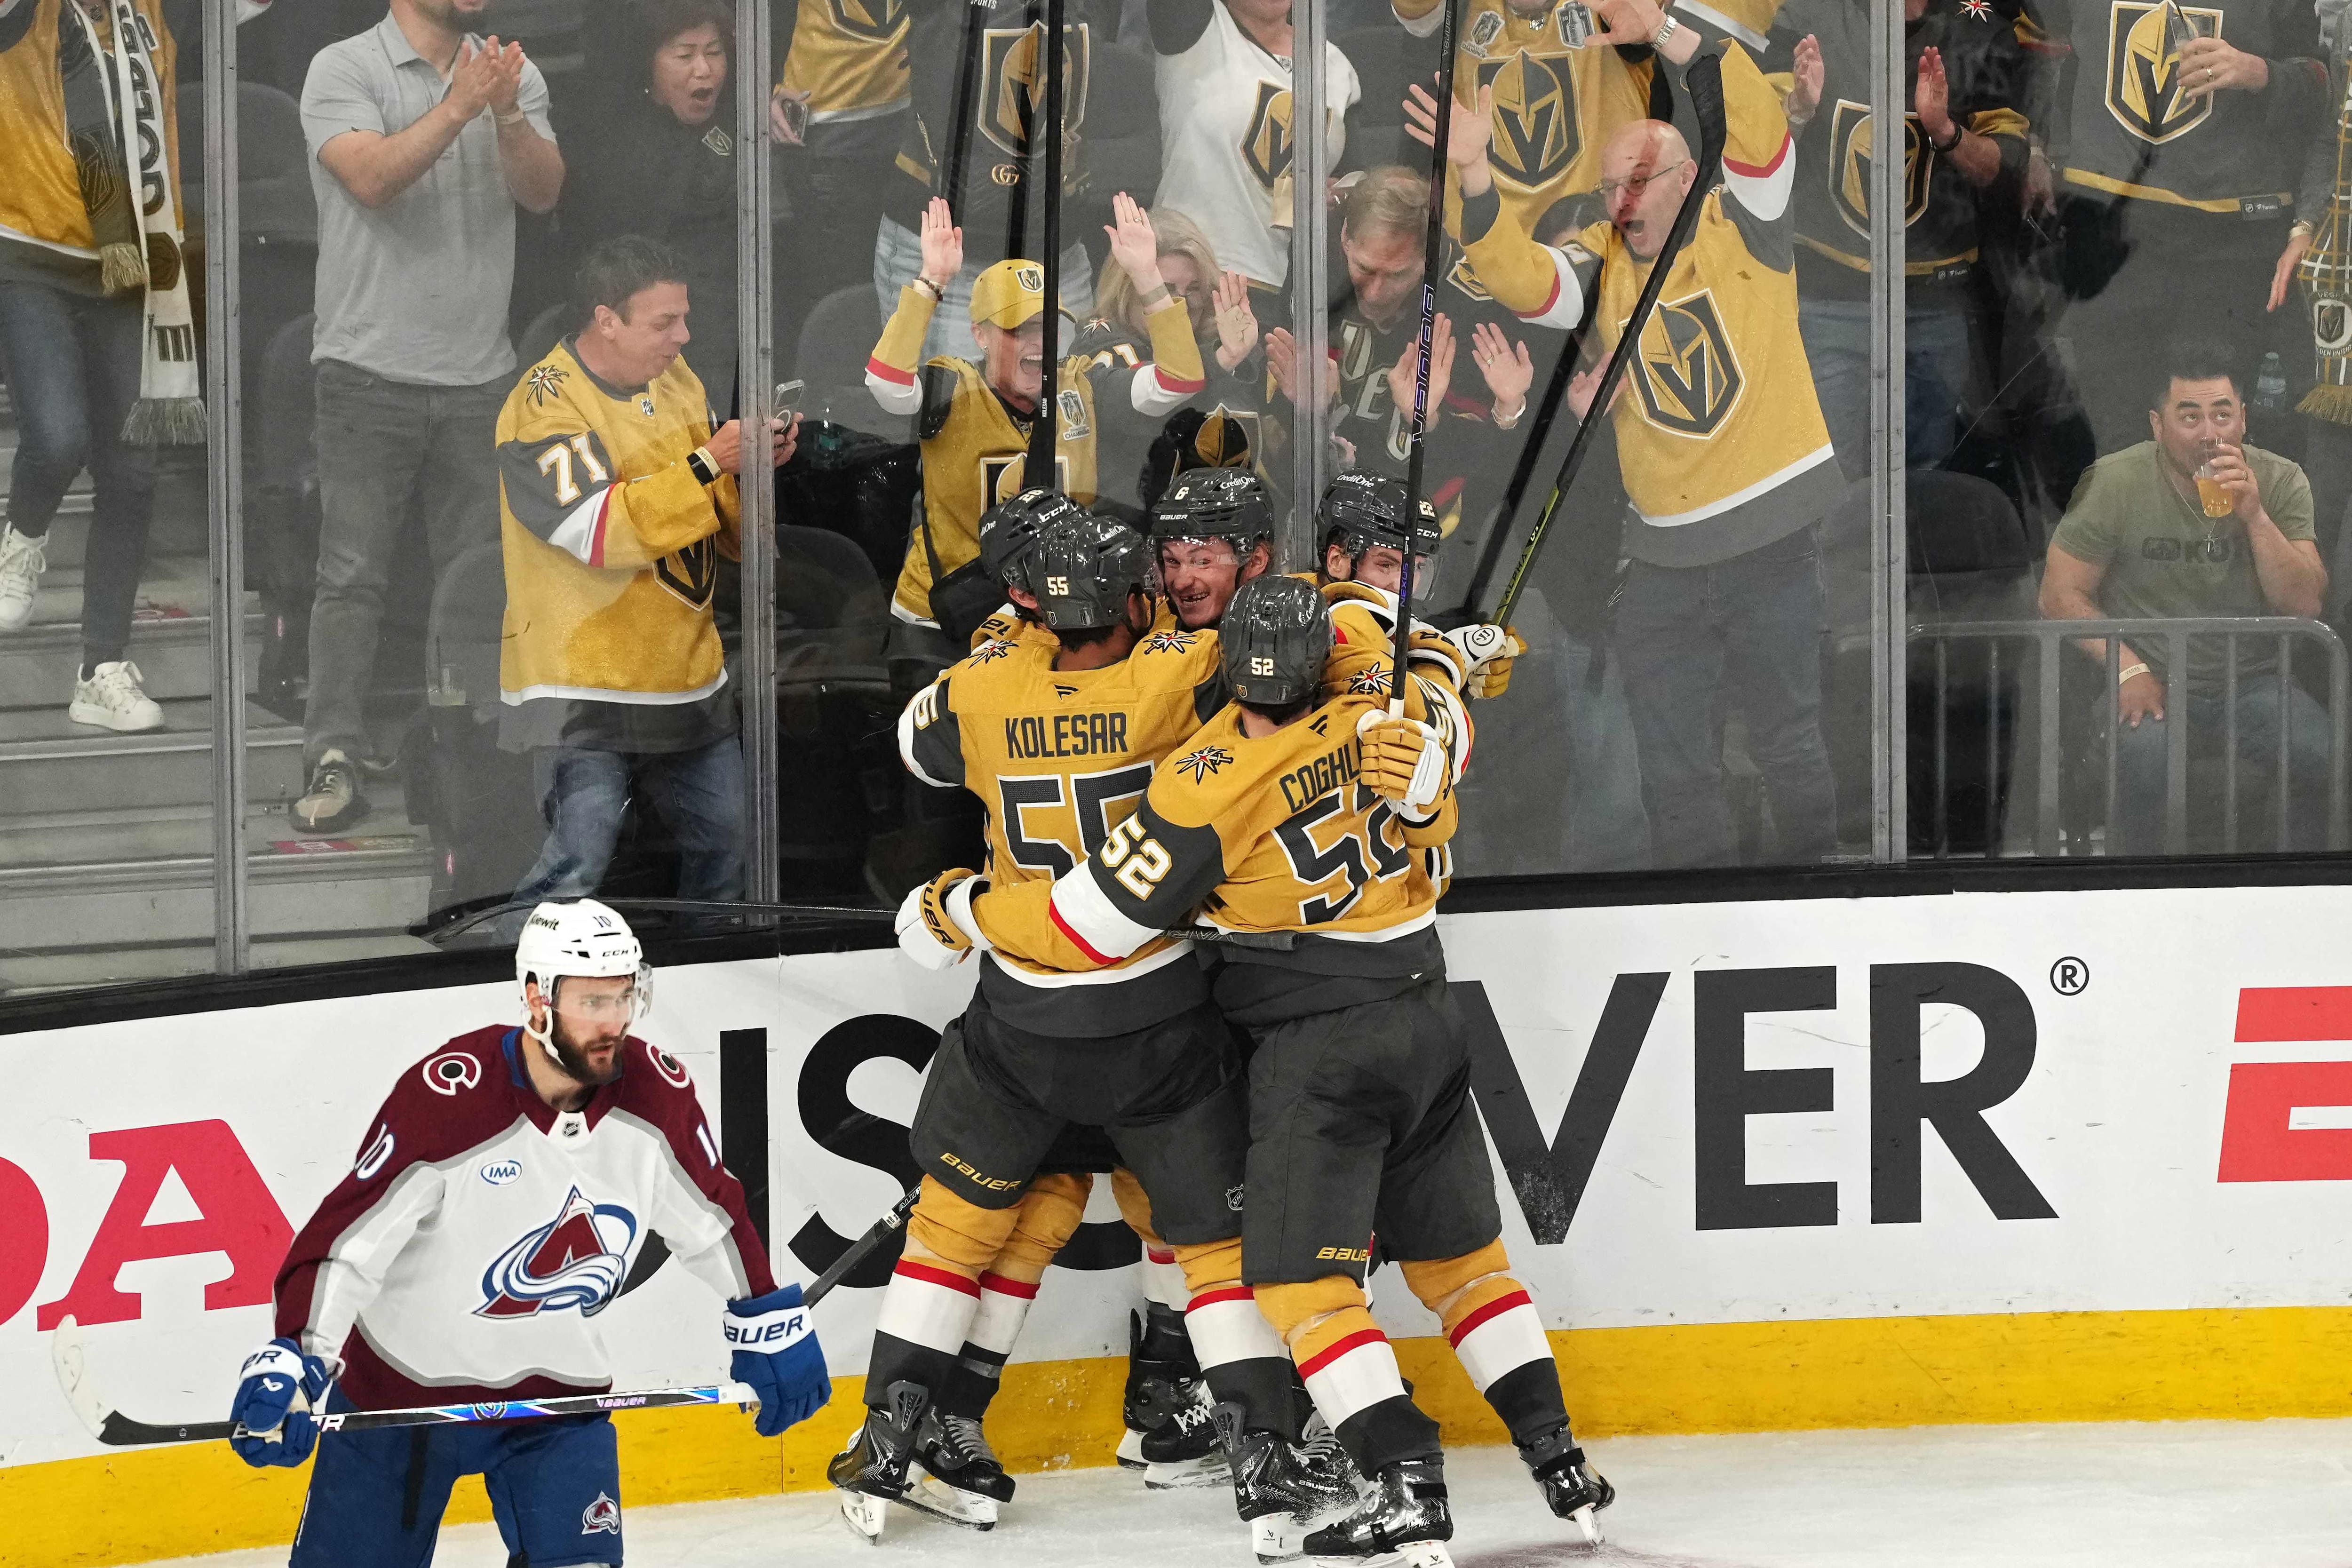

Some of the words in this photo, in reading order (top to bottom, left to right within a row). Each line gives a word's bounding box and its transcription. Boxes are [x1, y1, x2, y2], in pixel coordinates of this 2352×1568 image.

[536, 432, 610, 507] 71
[1337, 474, 1374, 488] CreditOne
[1174, 486, 1190, 500] 6
[1221, 476, 1256, 489] CreditOne
[1038, 502, 1068, 523] CCM
[1416, 528, 1438, 539] CCM
[1046, 576, 1069, 596] 55
[1400, 562, 1408, 607] NEXUS
[1505, 553, 1528, 601] ALPHA
[1251, 657, 1274, 676] 52
[1005, 711, 1128, 759] KOLESAR
[1279, 742, 1361, 813] COGHL
[1100, 812, 1173, 901] 52
[489, 1166, 516, 1178] IMA
[940, 1152, 1022, 1193] BAUER
[725, 1314, 804, 1344] AUER
